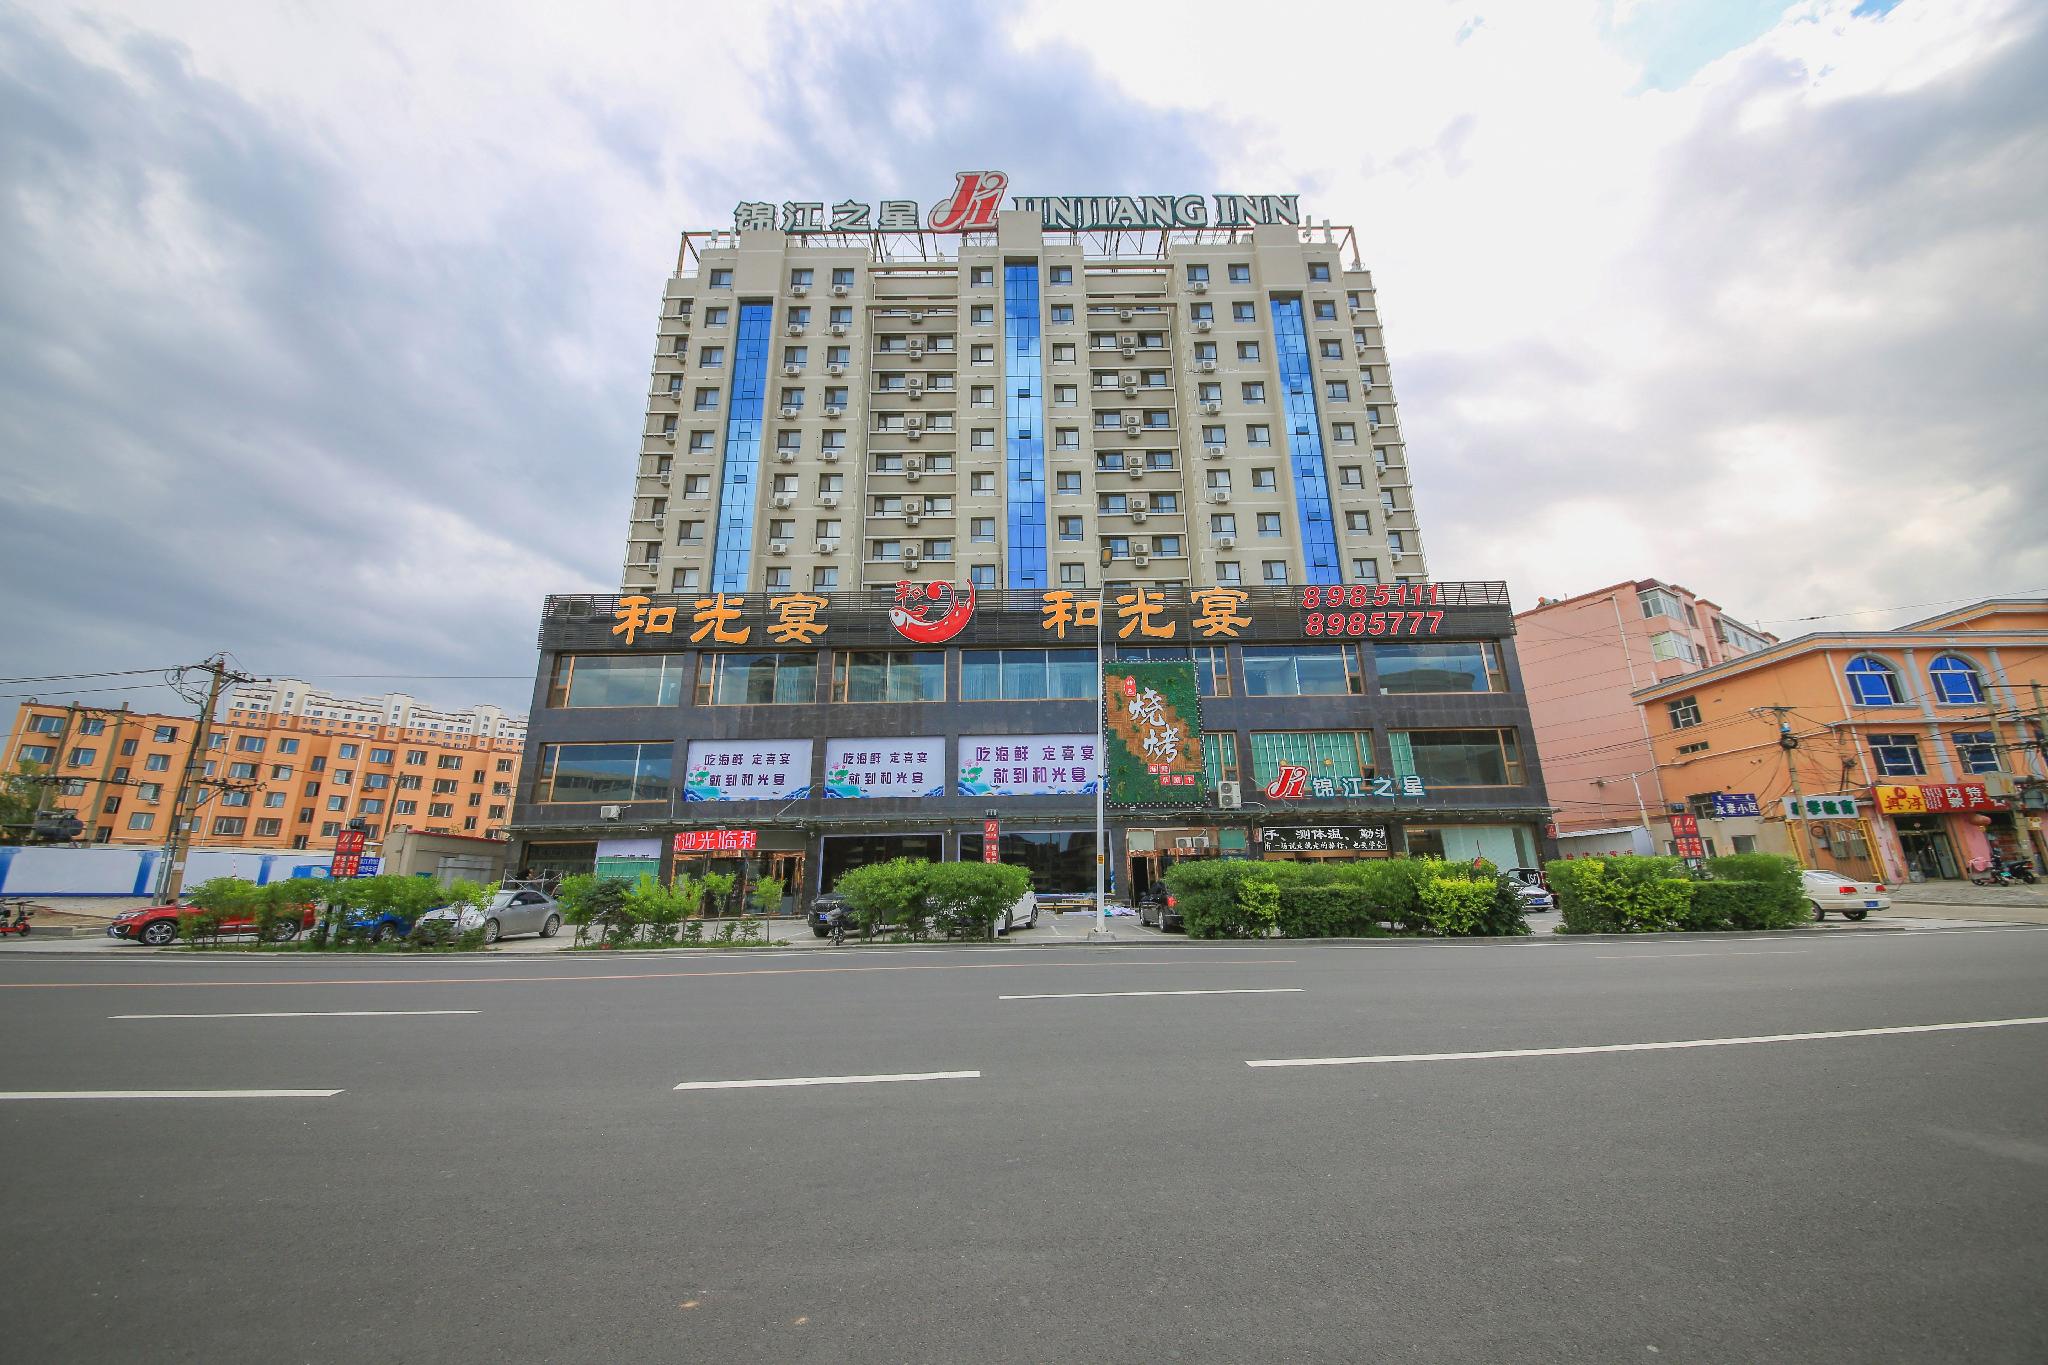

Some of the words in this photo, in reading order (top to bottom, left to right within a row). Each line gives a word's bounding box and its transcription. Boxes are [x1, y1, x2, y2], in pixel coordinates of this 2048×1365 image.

[733, 199, 919, 231] 锦江之星
[1212, 194, 1300, 226] INN
[1302, 584, 1439, 608] 8985111
[612, 592, 829, 645] 和光宴
[1042, 586, 1252, 638] 和光宴
[1305, 611, 1444, 636] 8985777
[1128, 687, 1180, 763] 烧烤
[704, 753, 744, 766] 吃海鲜
[751, 752, 791, 765] 定喜宴
[842, 752, 882, 765] 吃海鲜
[889, 751, 928, 764] 定喜宴
[975, 746, 1029, 762] 吃海鲜
[1042, 745, 1095, 761] 定喜宴
[708, 773, 786, 787] 就到和光宴
[848, 771, 924, 785] 就到和光宴
[993, 767, 1087, 784] 就到和光宴
[1311, 775, 1426, 799] 锦江之星
